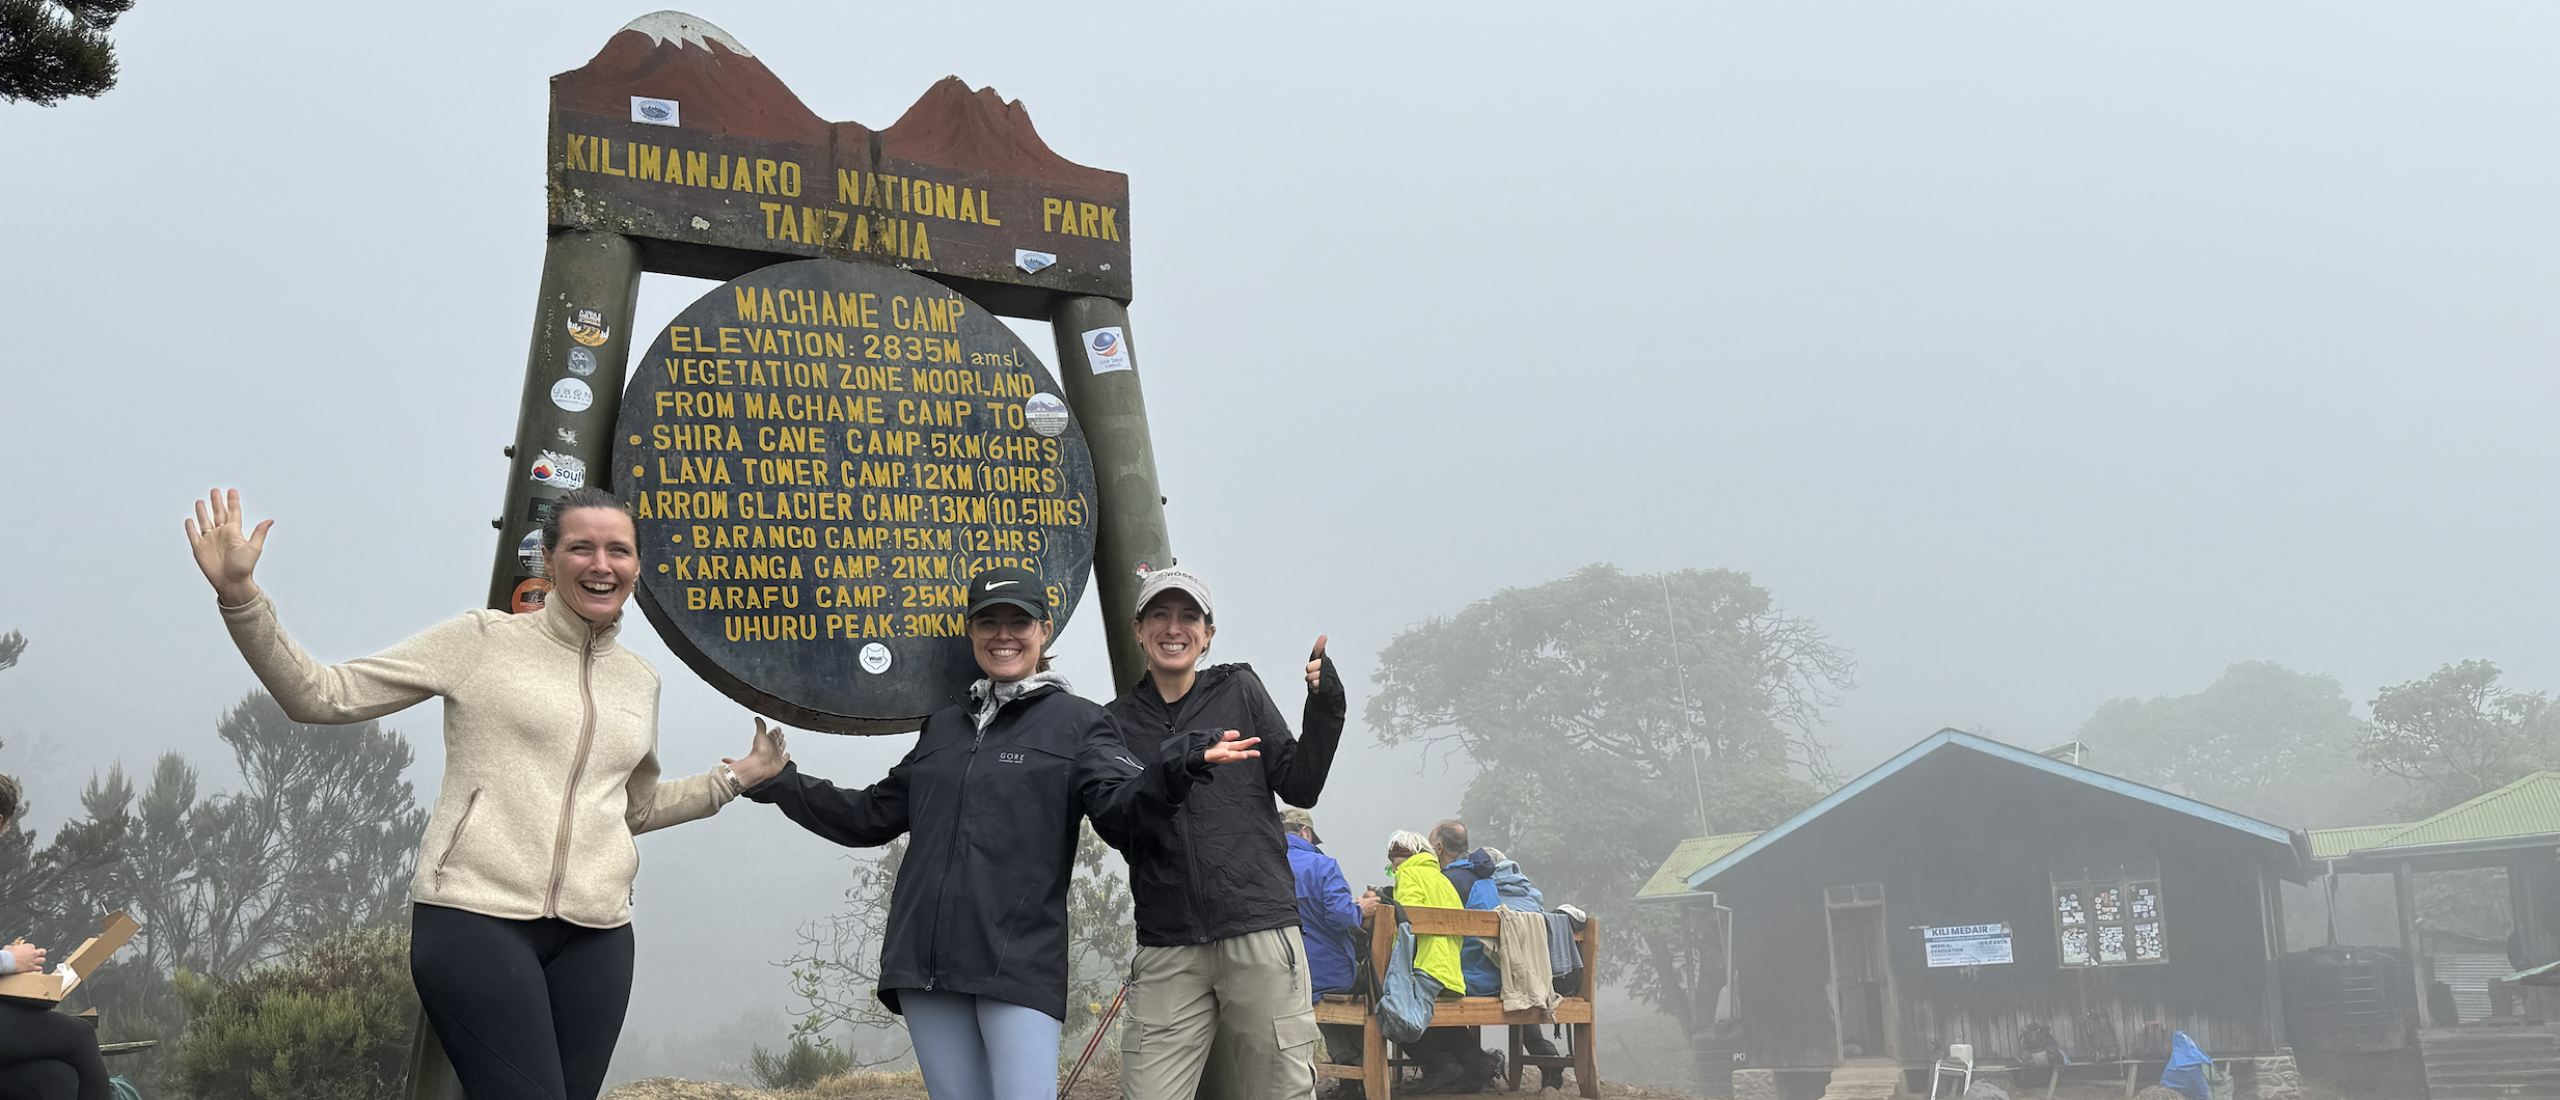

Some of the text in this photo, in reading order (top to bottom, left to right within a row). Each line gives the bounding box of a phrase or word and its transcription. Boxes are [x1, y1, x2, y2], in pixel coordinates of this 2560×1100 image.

[567, 133, 1120, 242] KILIMANJARO NATIONAL PARK
[759, 201, 932, 261] TANZANIA
[735, 286, 965, 333] MACHAME CAMP
[670, 326, 1024, 368] ELEVATION: 2835M amsl
[665, 358, 1035, 398] VEGETATION ZONE MOORLAND
[655, 391, 735, 419] FROM
[744, 392, 885, 424] MACHAME
[898, 399, 972, 427] CAMP
[653, 424, 744, 452] SHIRA
[758, 426, 826, 453] CAVE
[555, 468, 582, 483] soul
[658, 456, 731, 485] LAVA
[742, 458, 829, 486] TOWER
[638, 490, 729, 520] ARROW
[738, 491, 853, 521] GLACIER
[692, 525, 817, 549] BARANCO
[675, 554, 804, 581] KARANGA
[686, 585, 799, 611] BARAFU
[724, 614, 817, 642] UHURU
[1000, 752, 1025, 761] GORE
[1932, 928, 1949, 936] KILI
